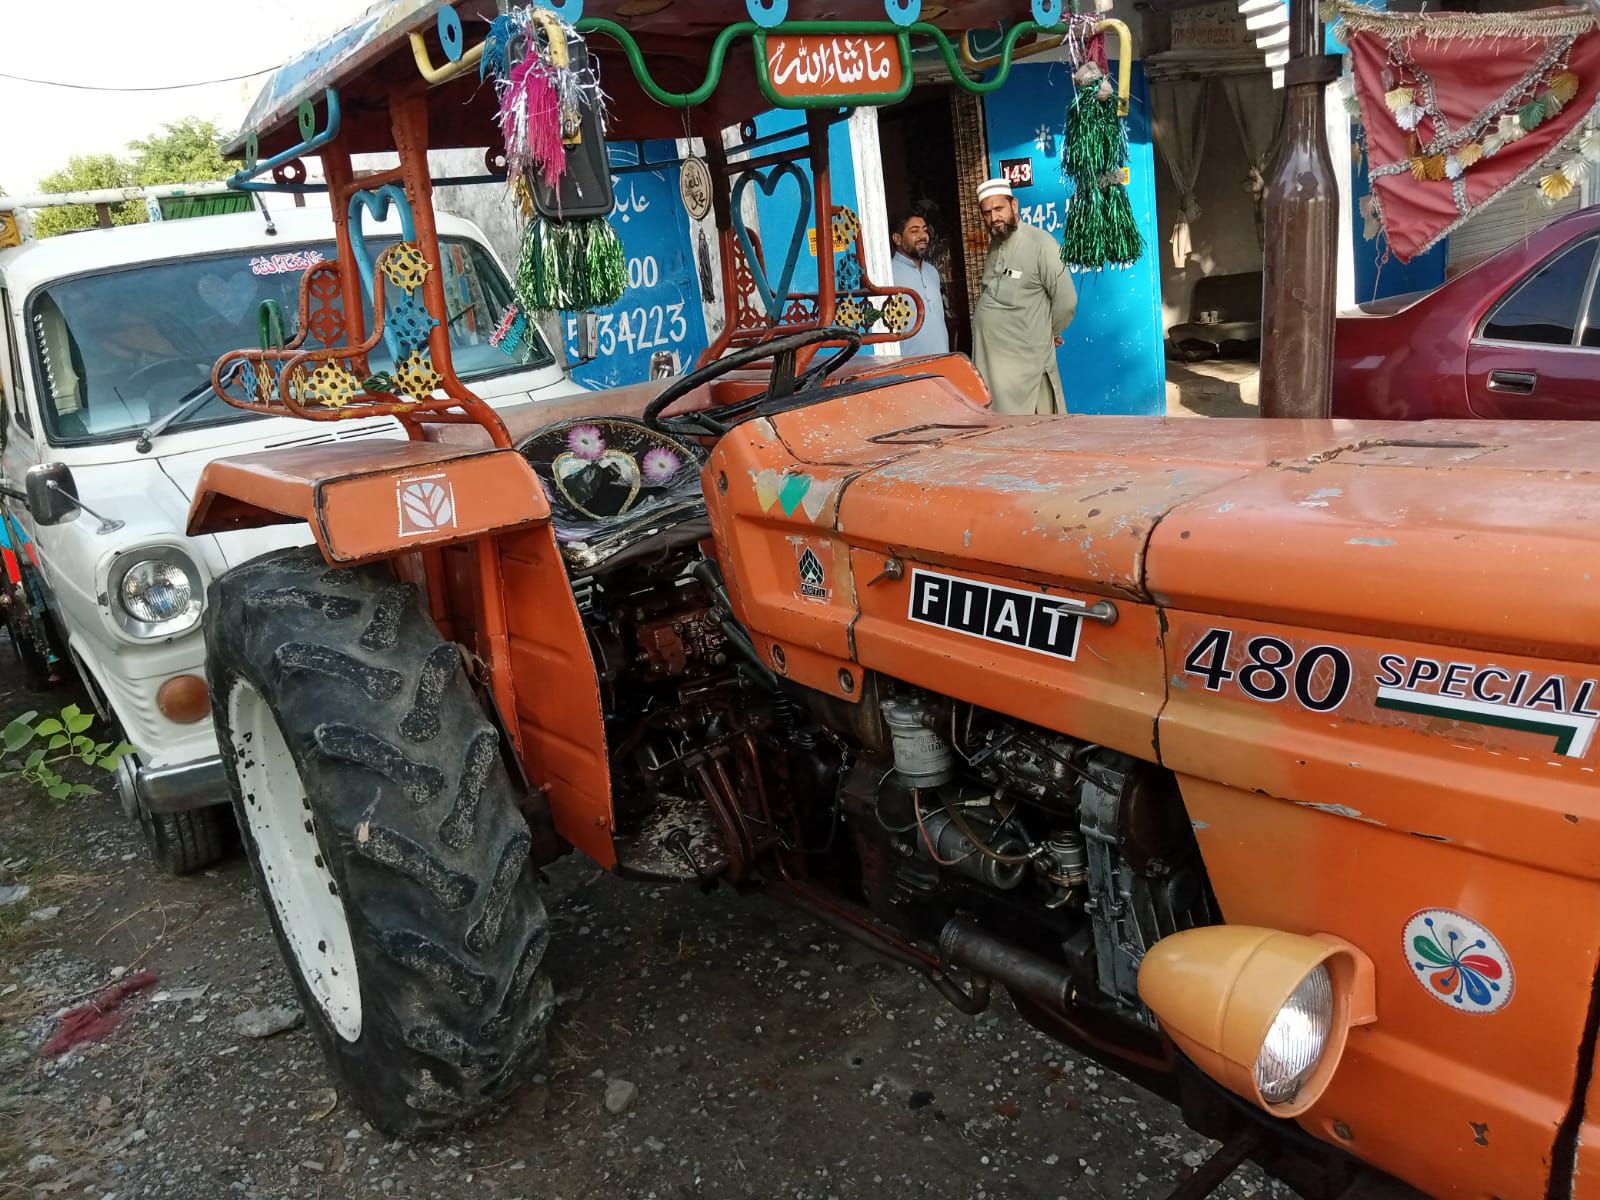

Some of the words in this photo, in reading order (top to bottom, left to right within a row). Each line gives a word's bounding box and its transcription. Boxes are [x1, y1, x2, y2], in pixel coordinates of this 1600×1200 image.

[920, 580, 1070, 647] FIAT
[1184, 627, 1352, 713] 480
[1373, 653, 1600, 719] SPECIAL
